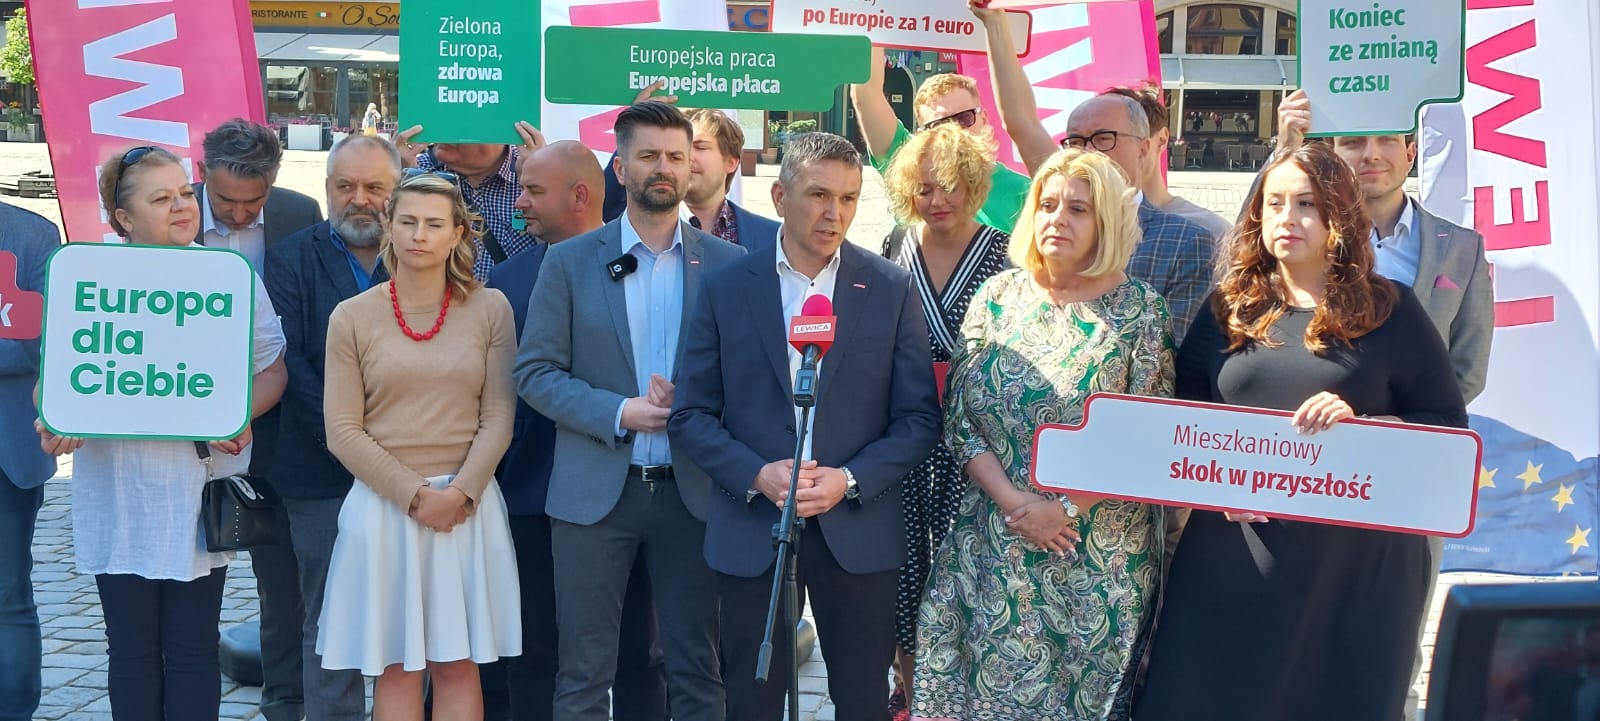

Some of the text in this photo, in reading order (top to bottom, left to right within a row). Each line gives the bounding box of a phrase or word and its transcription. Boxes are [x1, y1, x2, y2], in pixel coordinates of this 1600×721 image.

[251, 10, 307, 19] RISTORANTE
[439, 16, 502, 35] Zielona
[803, 8, 975, 35] po Europie za 1 euro
[1329, 3, 1405, 29] Koniec
[439, 40, 503, 61] Europa,
[630, 45, 776, 71] Europejska praca
[1328, 34, 1438, 64] ze zmianą
[438, 62, 503, 81] zdrowa
[629, 71, 781, 97] Europejska płaca
[1329, 75, 1390, 93] czasu
[438, 86, 499, 108] Europa
[75, 281, 233, 326] Europa
[72, 321, 144, 355] dla
[795, 324, 828, 332] LEWICA
[70, 360, 214, 398] Ciebie
[1173, 424, 1323, 466] Mieszkaniowy
[1169, 457, 1373, 501] skok w przyszłość
